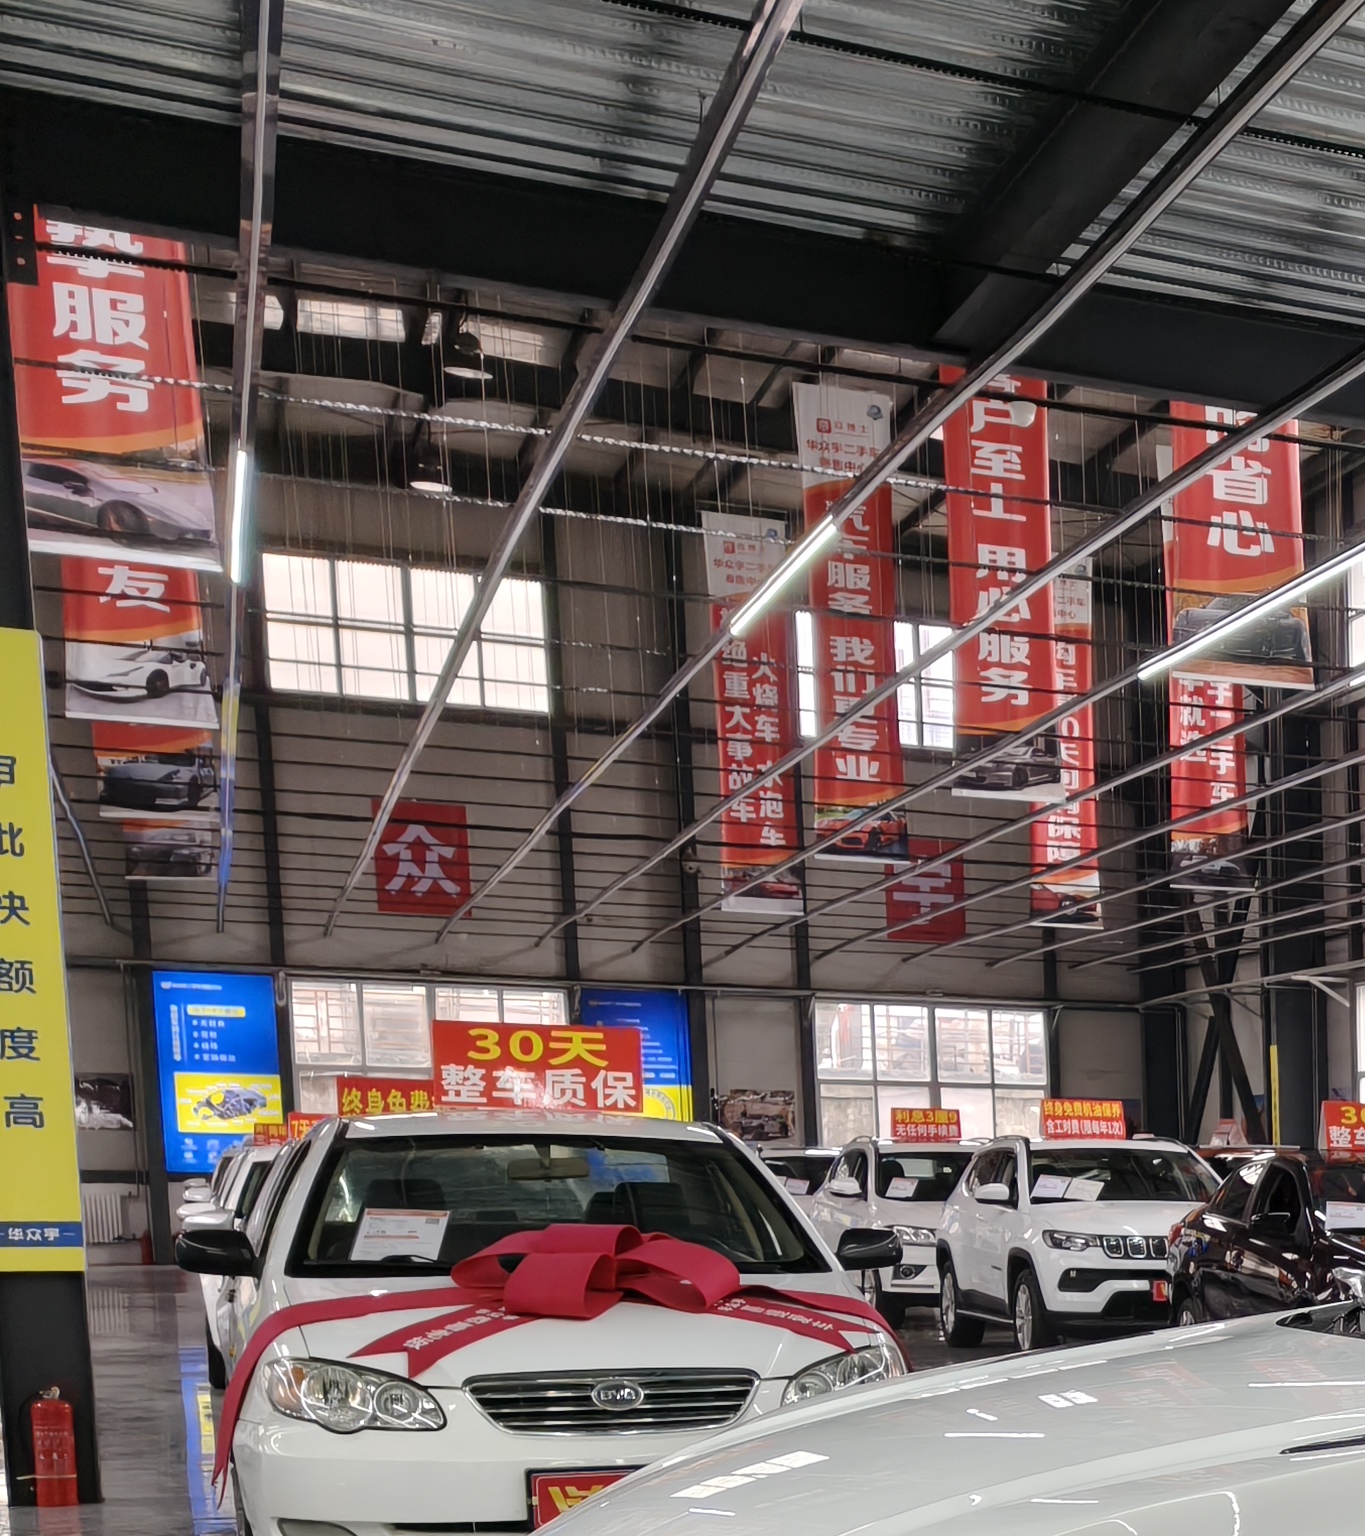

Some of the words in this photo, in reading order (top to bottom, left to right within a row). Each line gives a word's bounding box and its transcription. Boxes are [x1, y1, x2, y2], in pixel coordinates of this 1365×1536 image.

[971, 374, 1027, 522] 户至上
[97, 565, 171, 614] 友
[383, 823, 463, 898] 众
[467, 1027, 609, 1068] 30天
[341, 1087, 436, 1116] 终身免费
[441, 1063, 638, 1110] 整车质保
